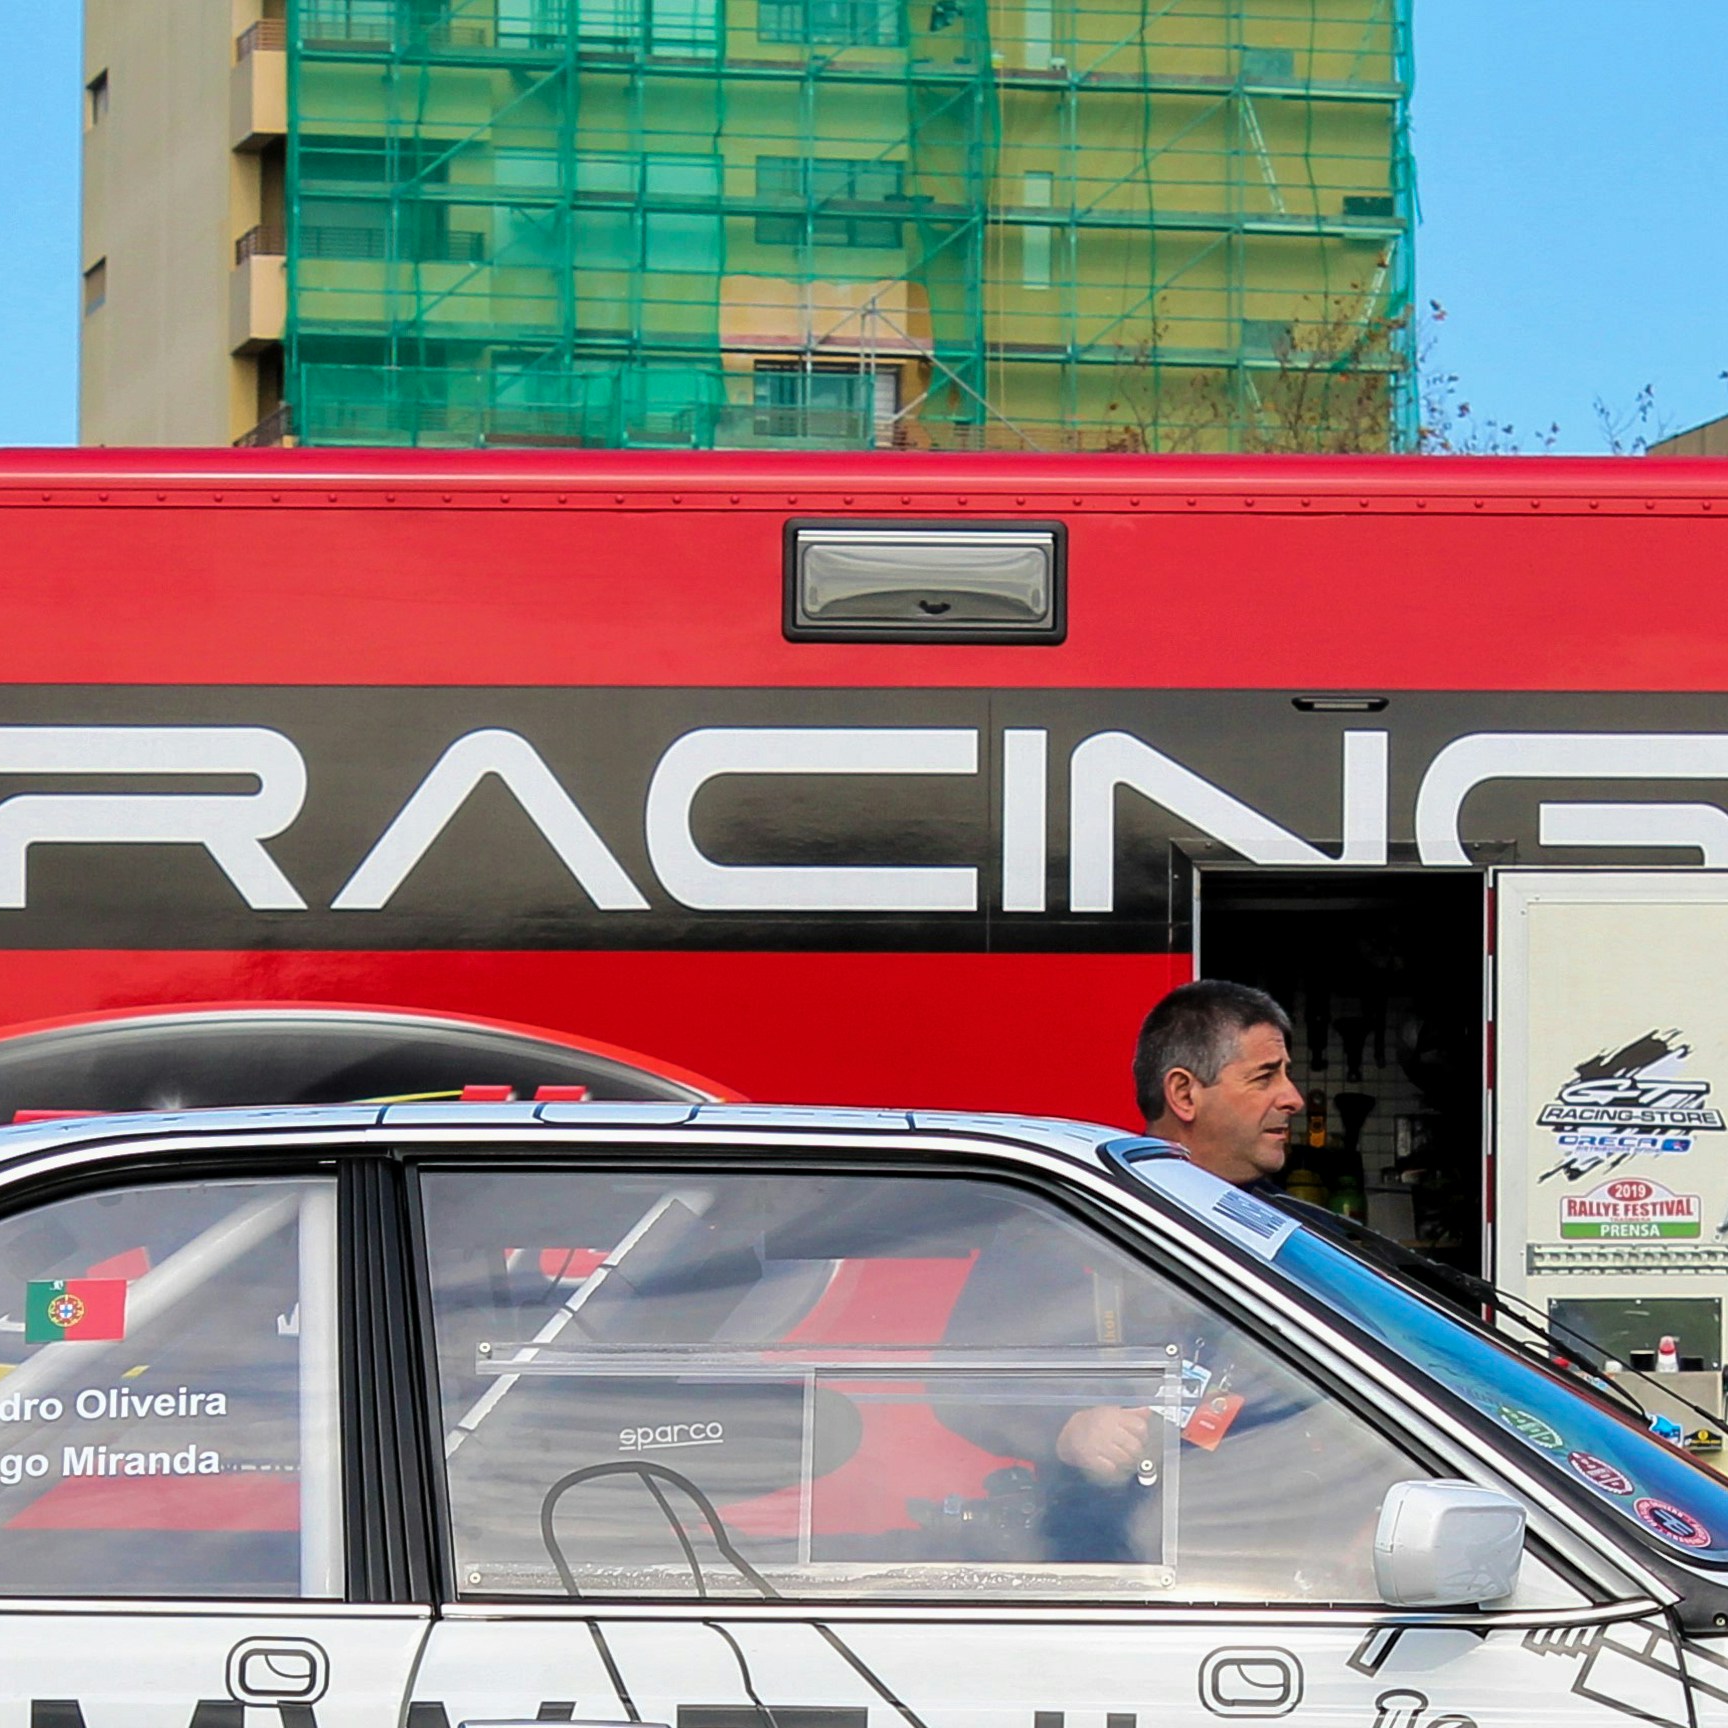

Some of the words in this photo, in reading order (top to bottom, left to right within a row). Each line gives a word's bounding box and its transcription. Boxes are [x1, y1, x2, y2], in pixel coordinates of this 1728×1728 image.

[1545, 1107, 1719, 1125] RACING-STORE
[1558, 1134, 1658, 1147] ORECA
[1614, 1184, 1647, 1199] 2019
[1567, 1199, 1620, 1217] RALLYE
[1624, 1197, 1694, 1217] FESTIVAL
[1600, 1224, 1661, 1237] PRENSA
[75, 1387, 228, 1420] Oliveira
[619, 1418, 724, 1448] sparco
[62, 1444, 221, 1478] Miranda
